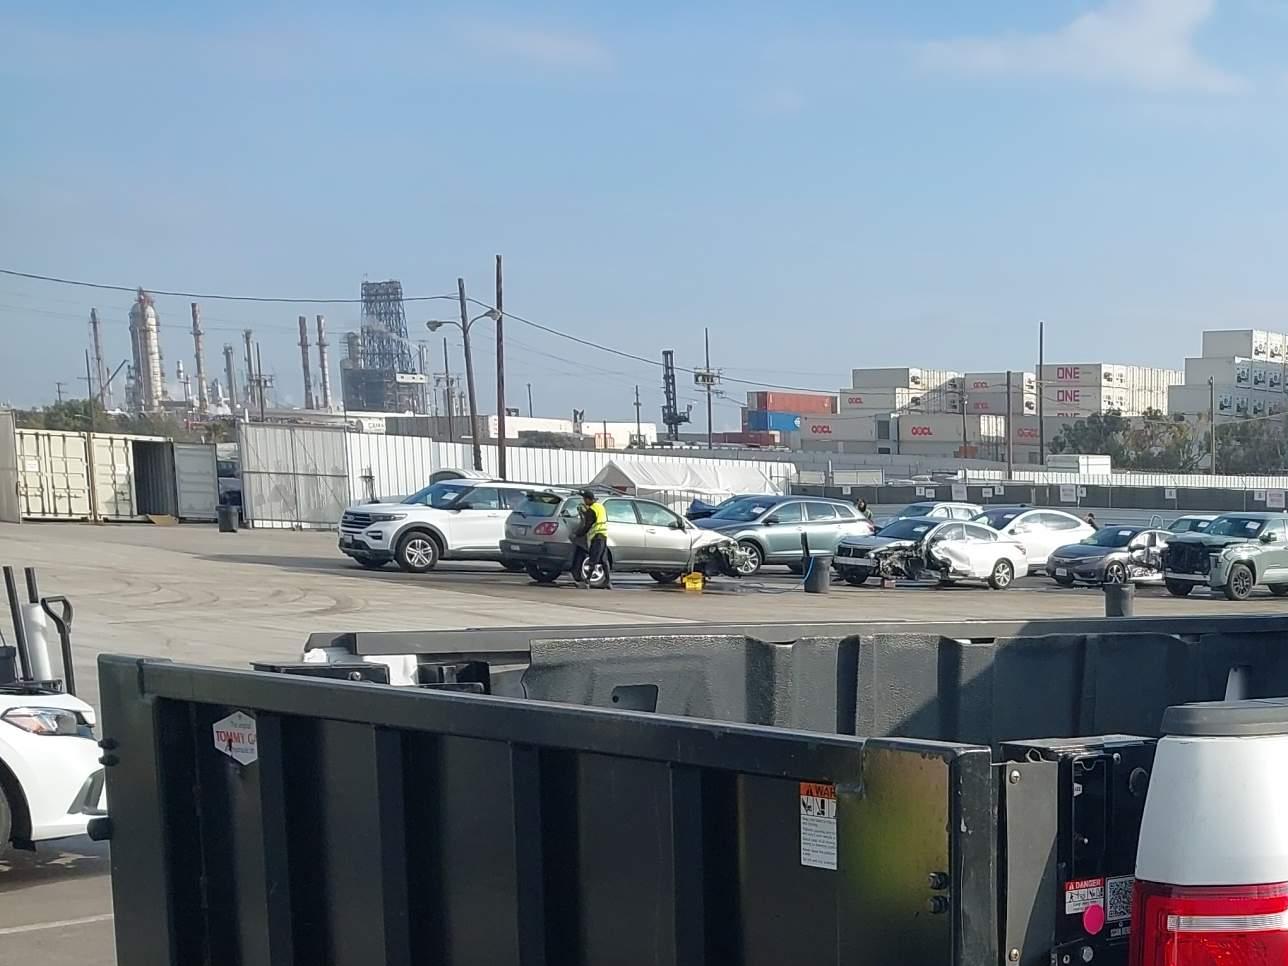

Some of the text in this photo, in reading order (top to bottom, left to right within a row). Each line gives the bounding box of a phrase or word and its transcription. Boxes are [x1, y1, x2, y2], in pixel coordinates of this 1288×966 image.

[1057, 367, 1081, 379] ONE
[1057, 390, 1081, 402] ONE
[811, 425, 832, 434] OOCL
[911, 426, 933, 435] OOCL
[215, 730, 246, 745] TOMMY
[1075, 878, 1101, 889] DANGER
